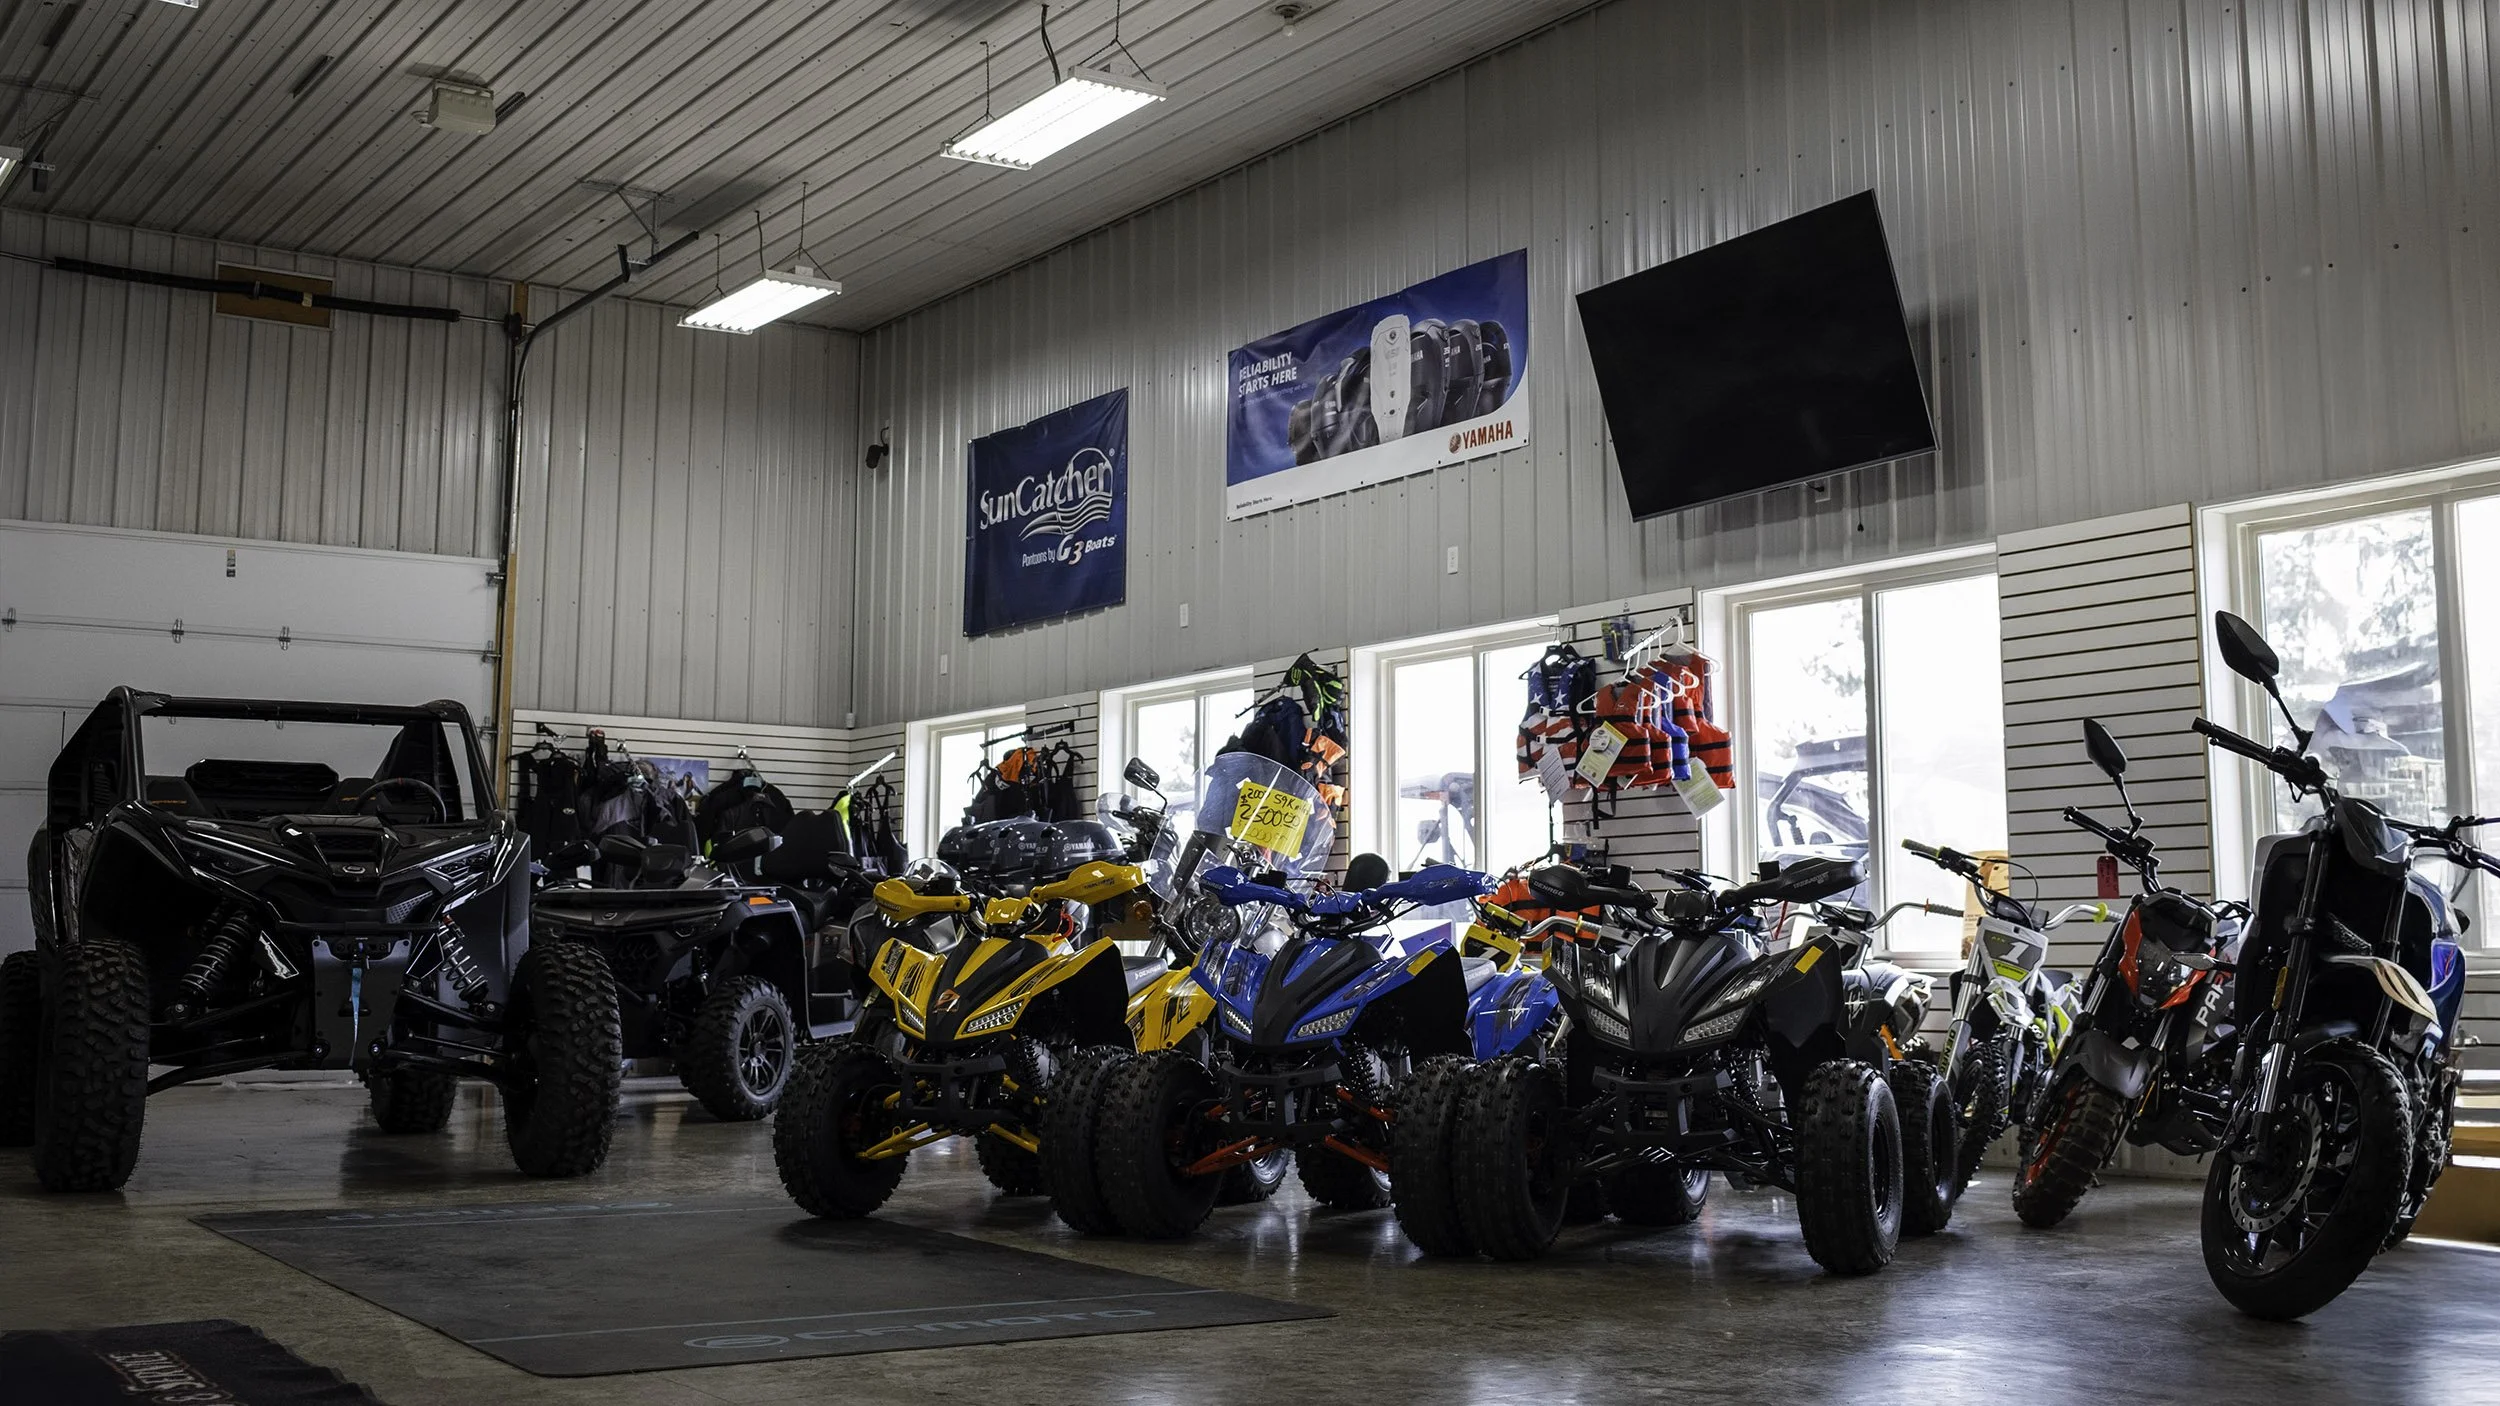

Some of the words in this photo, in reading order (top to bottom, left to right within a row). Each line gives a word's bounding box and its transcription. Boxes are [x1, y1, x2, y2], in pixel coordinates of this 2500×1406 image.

[1238, 375, 1270, 398] STARTS
[1270, 367, 1297, 386] HERE
[1463, 420, 1514, 450] YAMAHA
[979, 460, 1108, 530] SunCatcher
[1022, 549, 1047, 568] Pontoons
[1048, 548, 1056, 565] by
[1056, 534, 1084, 565] G3
[1084, 536, 1116, 554] Boats
[2000, 941, 2030, 964] 1
[794, 1309, 1156, 1341] CFMOTO
